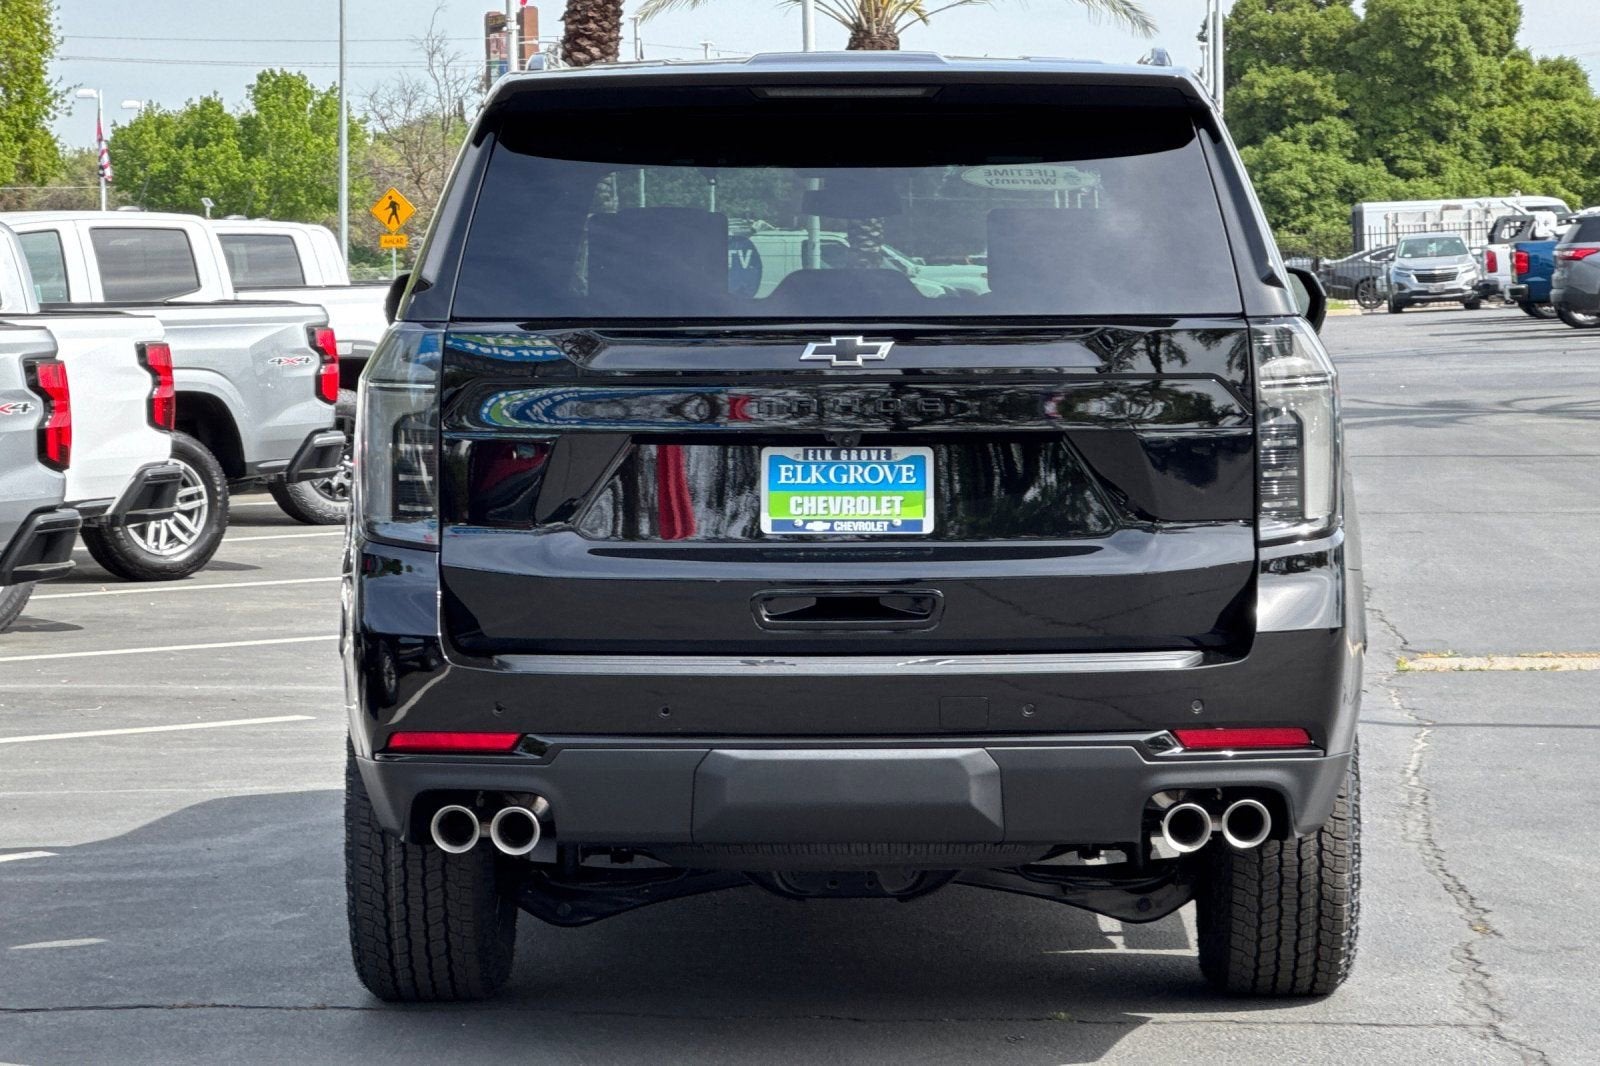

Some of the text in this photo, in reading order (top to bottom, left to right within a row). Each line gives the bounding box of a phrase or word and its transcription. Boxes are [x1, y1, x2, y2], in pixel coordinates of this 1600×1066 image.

[807, 449, 887, 461] ELK GROVE
[777, 464, 917, 484] ELK GROVE
[789, 495, 904, 517] CHEVROLET
[833, 521, 889, 532] CHEVROLET
